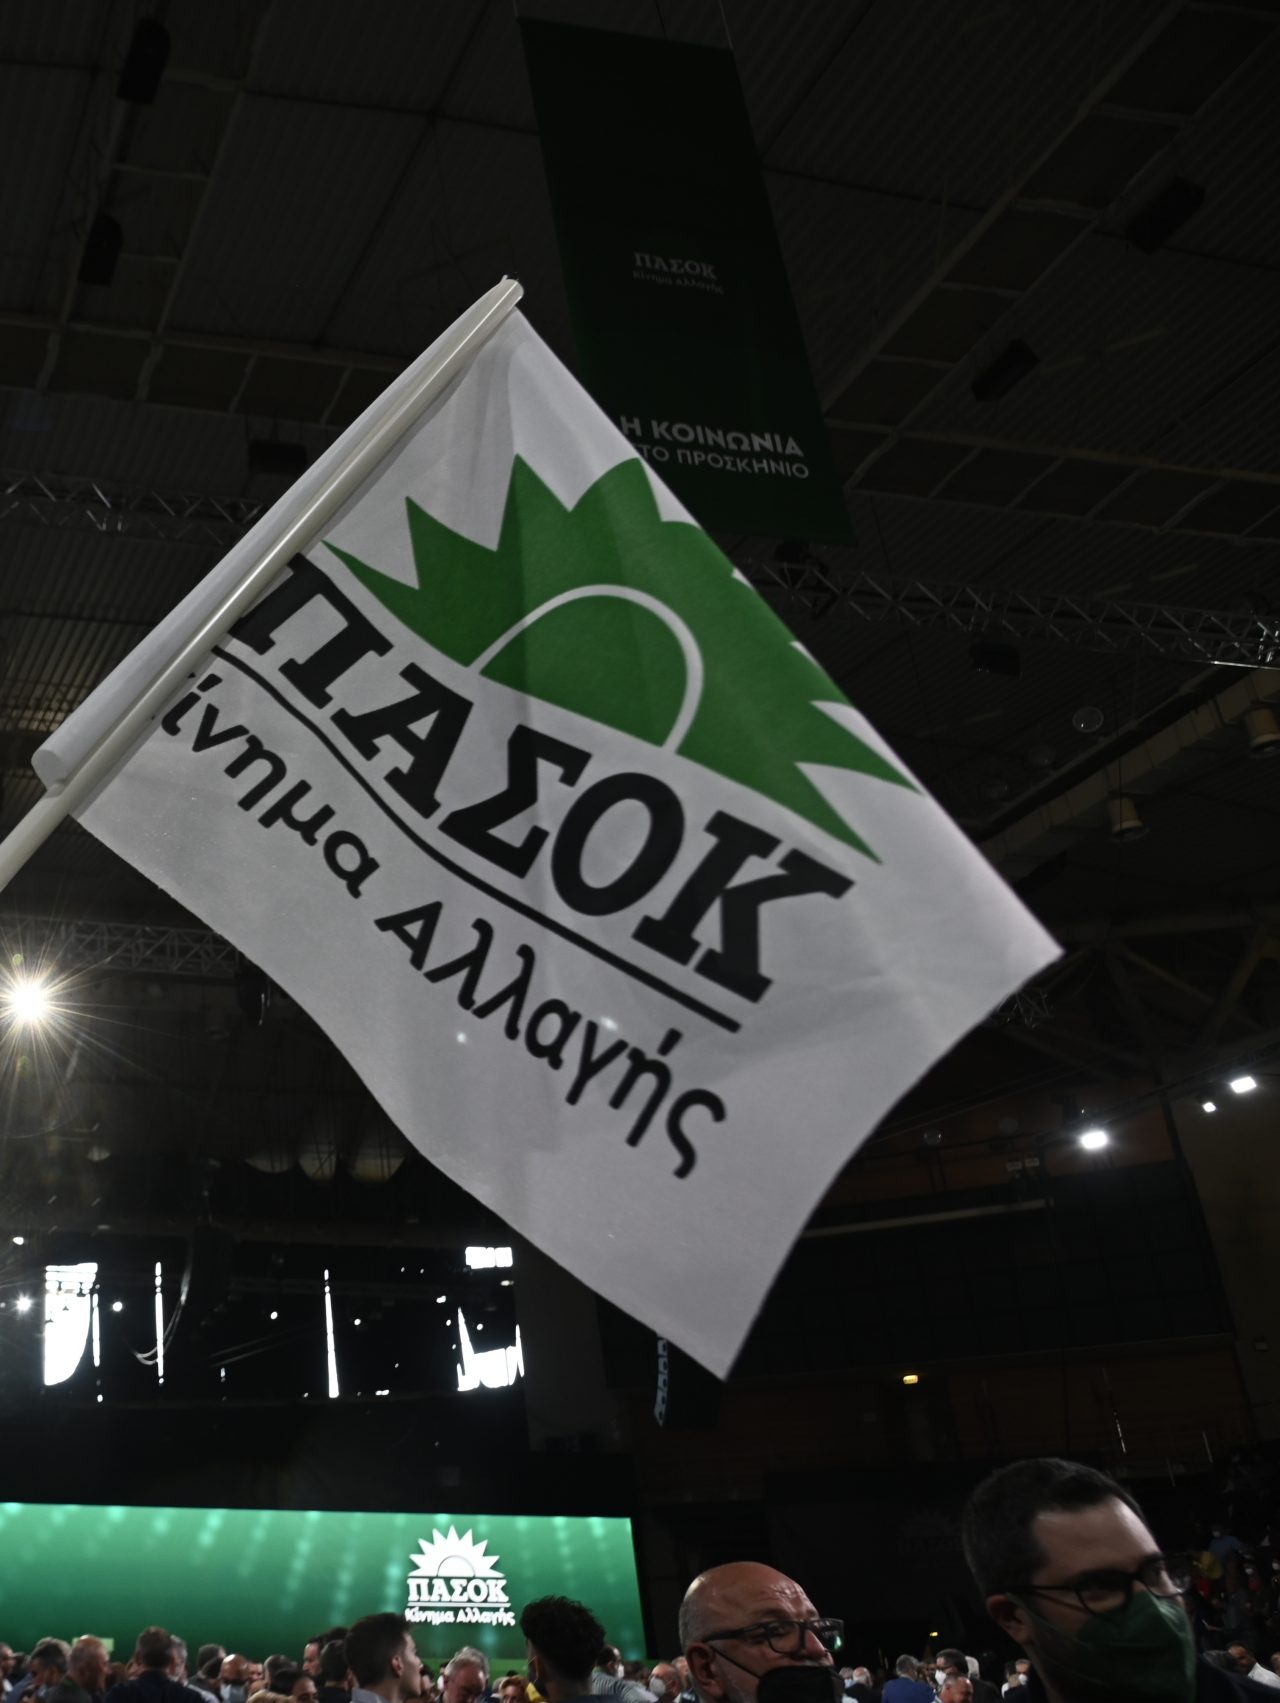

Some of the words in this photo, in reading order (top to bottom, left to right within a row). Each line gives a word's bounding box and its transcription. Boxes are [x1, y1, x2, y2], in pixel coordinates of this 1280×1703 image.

[620, 415, 643, 438] Η
[651, 419, 804, 457] ΚΟΙΝΩΝΙΑ
[637, 443, 670, 463] ΤΟ
[676, 448, 810, 479] ΠΡΟΣΚΗΝΙΟ
[227, 552, 856, 1004] ΠΑΣΟΚ
[161, 672, 381, 900] ίνημα
[374, 900, 727, 1180] Αλλαγής
[406, 1578, 510, 1603] ΠΑΣΟΚ
